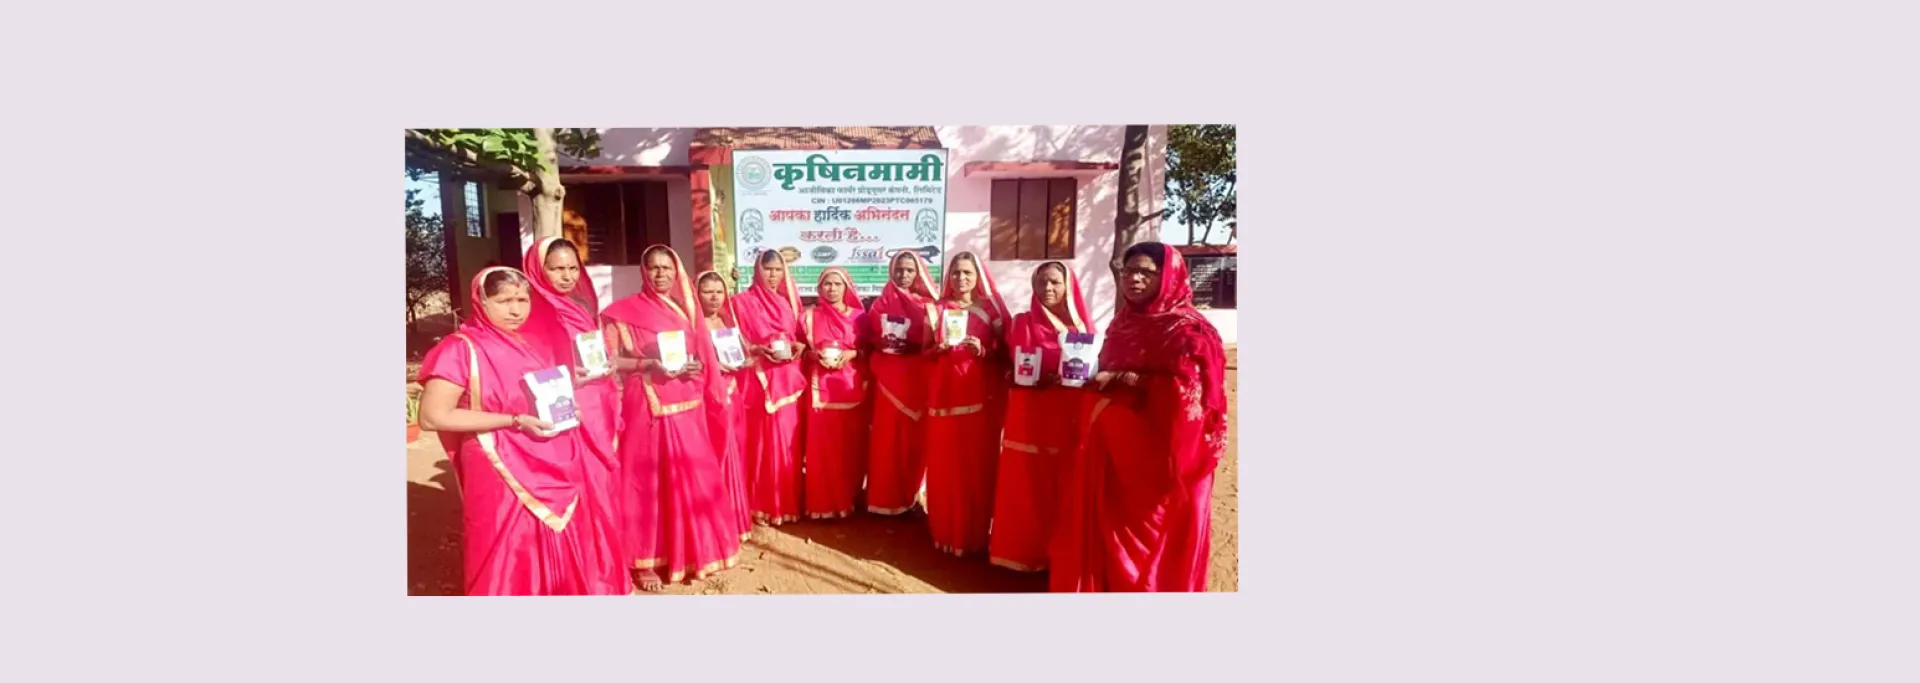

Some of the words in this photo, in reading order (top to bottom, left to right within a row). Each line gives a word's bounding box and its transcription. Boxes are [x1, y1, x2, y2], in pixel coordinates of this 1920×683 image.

[772, 154, 944, 190] कृषिनमामी
[769, 209, 812, 222] आपका
[814, 206, 852, 224] हार्दिक
[853, 207, 911, 222] अभिनंदन
[799, 227, 844, 243] करती
